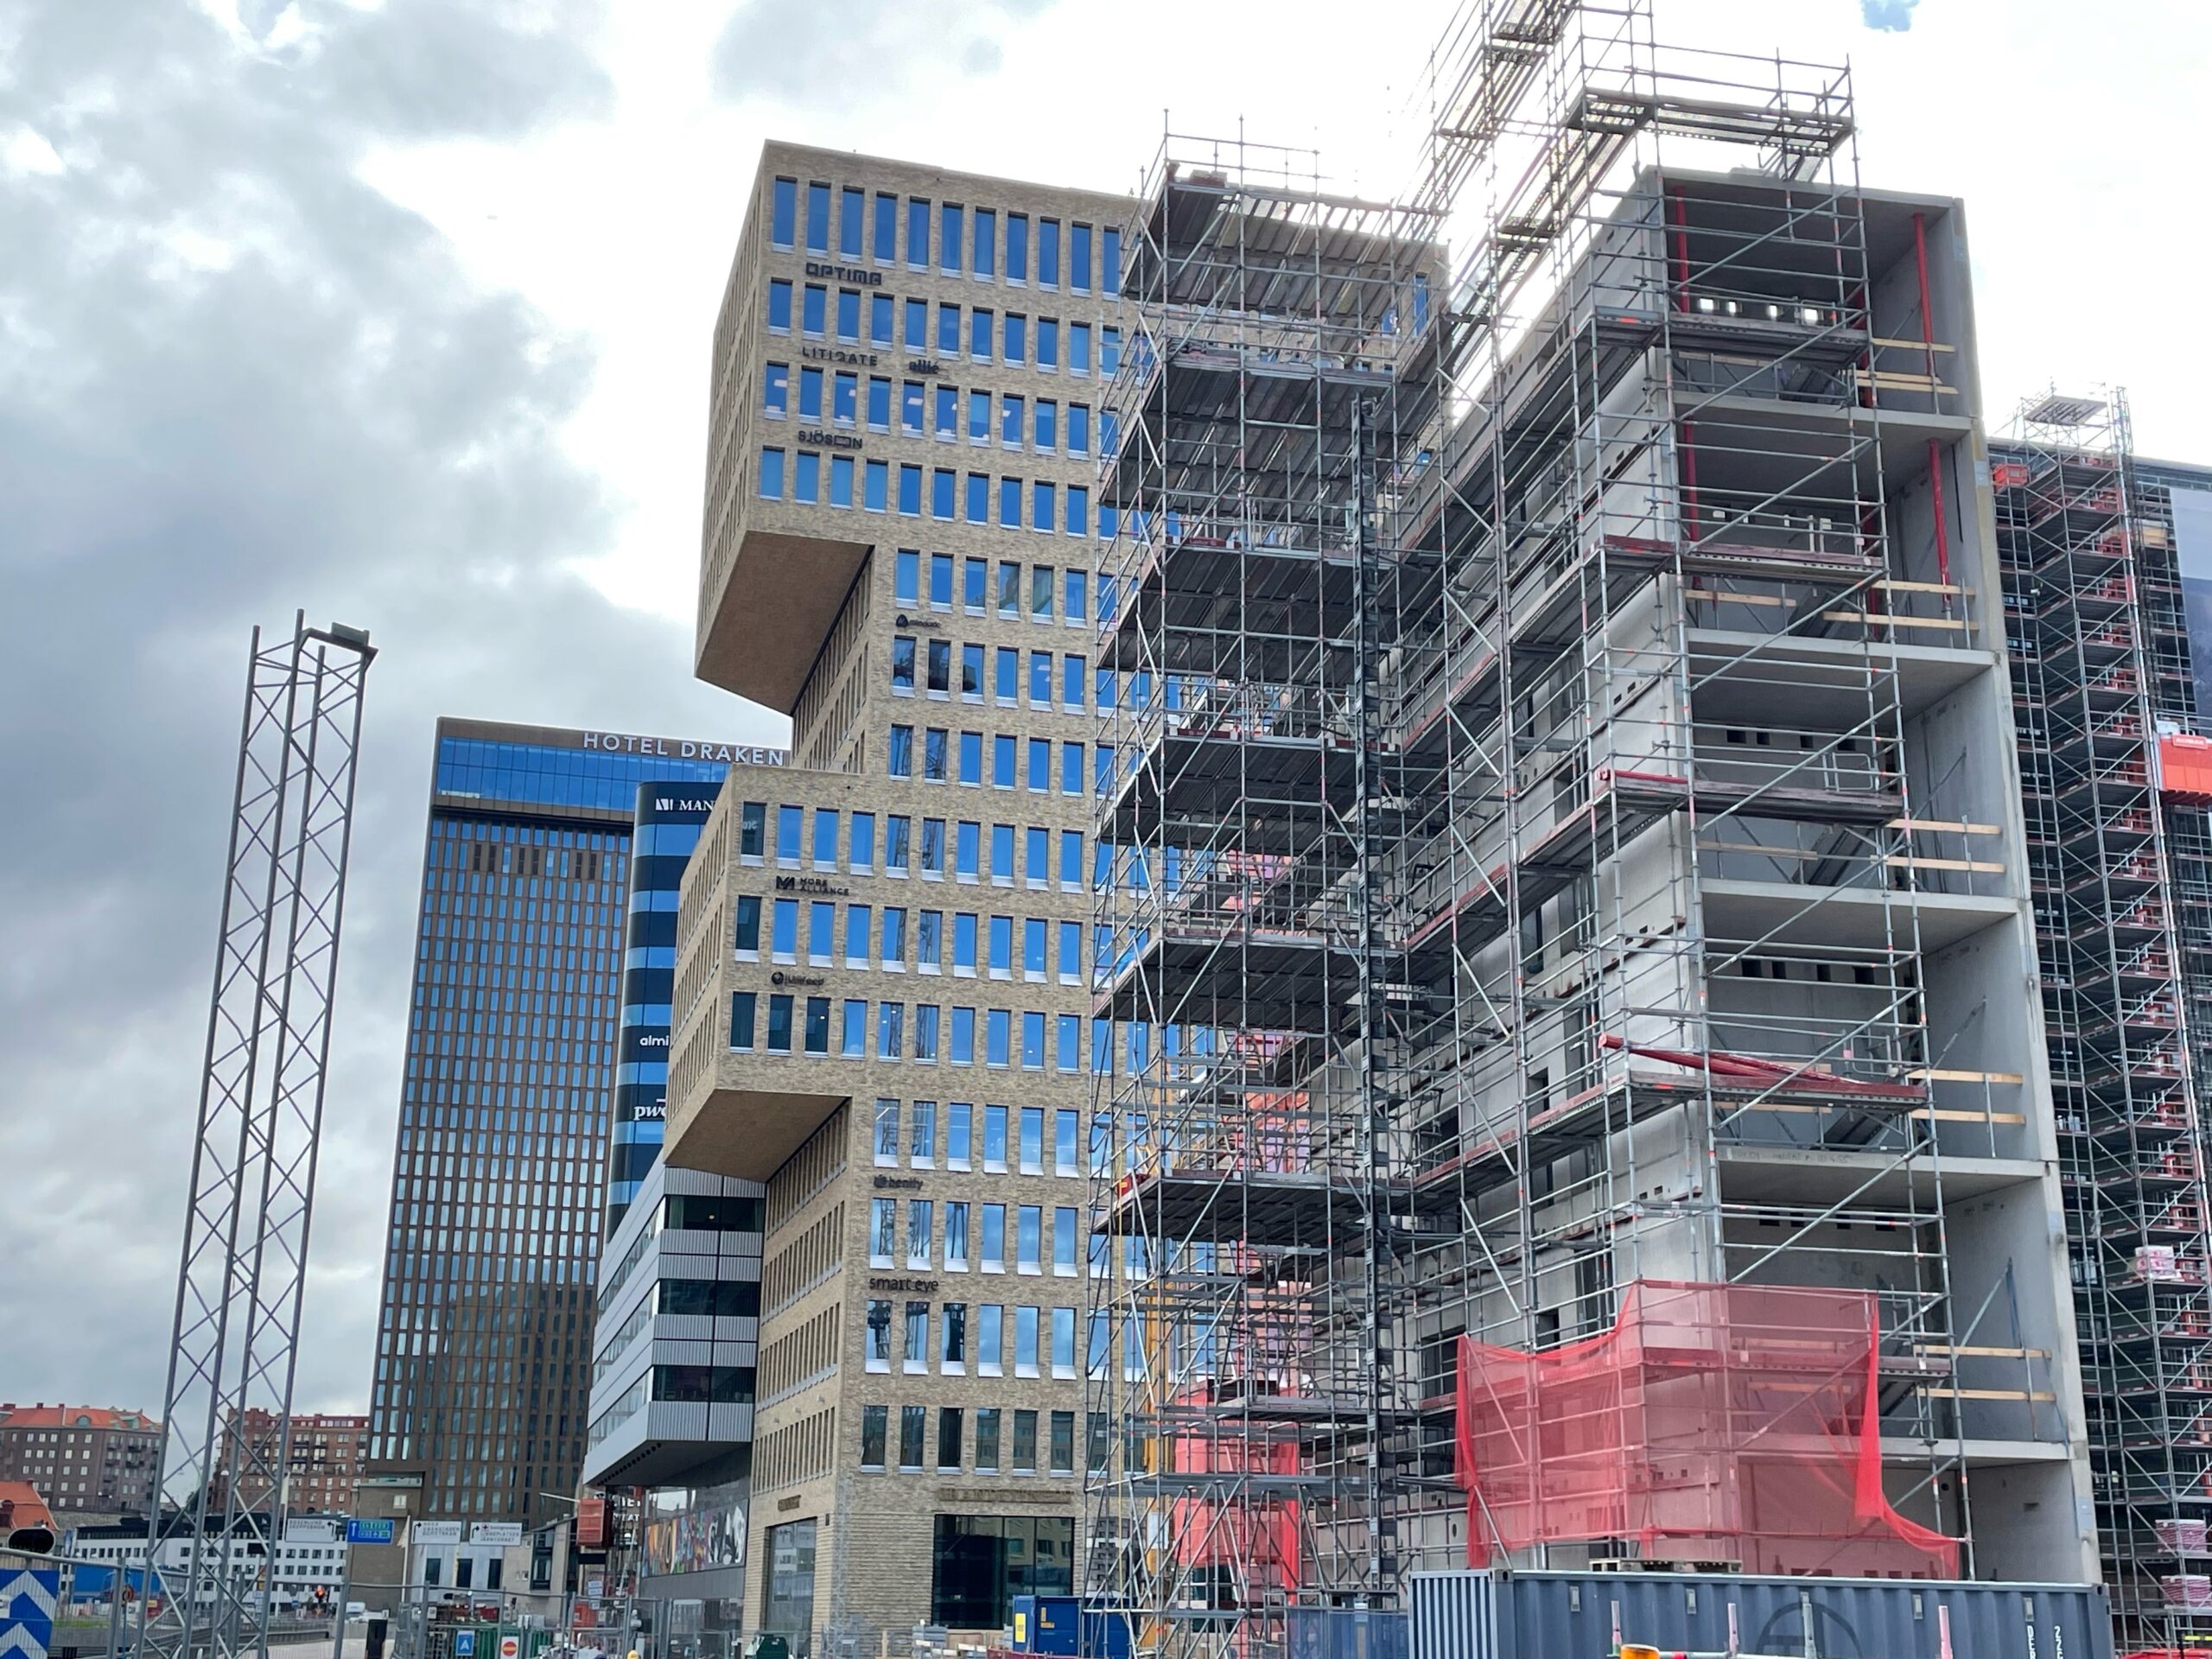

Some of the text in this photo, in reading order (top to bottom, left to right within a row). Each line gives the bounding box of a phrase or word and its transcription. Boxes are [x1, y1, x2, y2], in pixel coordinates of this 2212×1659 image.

[583, 732, 784, 766] HOTEL DRAKEN
[800, 877, 828, 887] MORE
[799, 886, 849, 895] ALLIANCE
[639, 1035, 670, 1046] almi
[868, 1278, 939, 1294] smart eye
